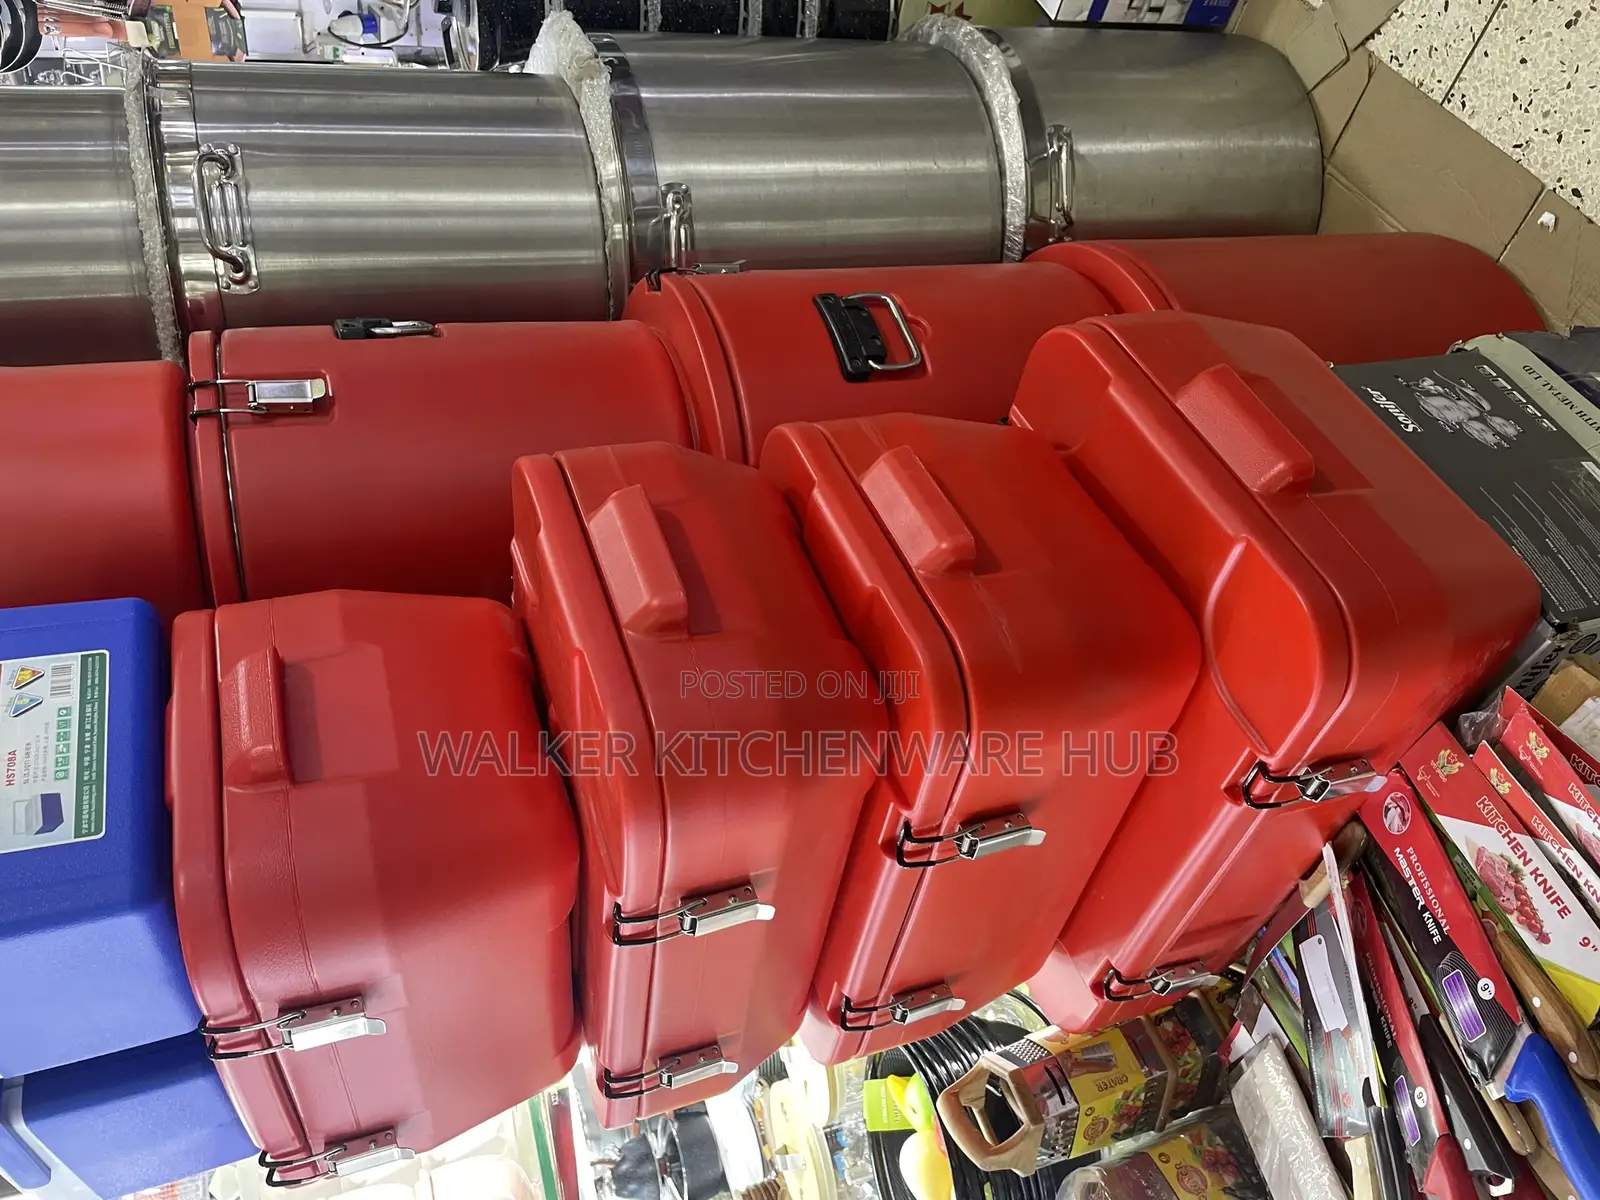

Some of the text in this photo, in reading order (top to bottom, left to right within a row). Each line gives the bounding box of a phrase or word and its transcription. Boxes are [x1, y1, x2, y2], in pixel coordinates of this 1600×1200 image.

[1522, 365, 1543, 380] LID
[1361, 386, 1424, 433] Sonifer
[1542, 380, 1578, 410] METAL
[5, 749, 18, 787] HS708A
[1476, 796, 1572, 920] KITCHEN KNIFE
[1531, 815, 1583, 879] KITCHEN
[1406, 846, 1451, 935] PROFISSIONAL
[1422, 911, 1442, 945] KNIFE
[1579, 936, 1598, 952] 9"
[1481, 983, 1492, 996] 9"
[1380, 1015, 1393, 1049] KNIFE
[1096, 1074, 1129, 1093] GRATER
